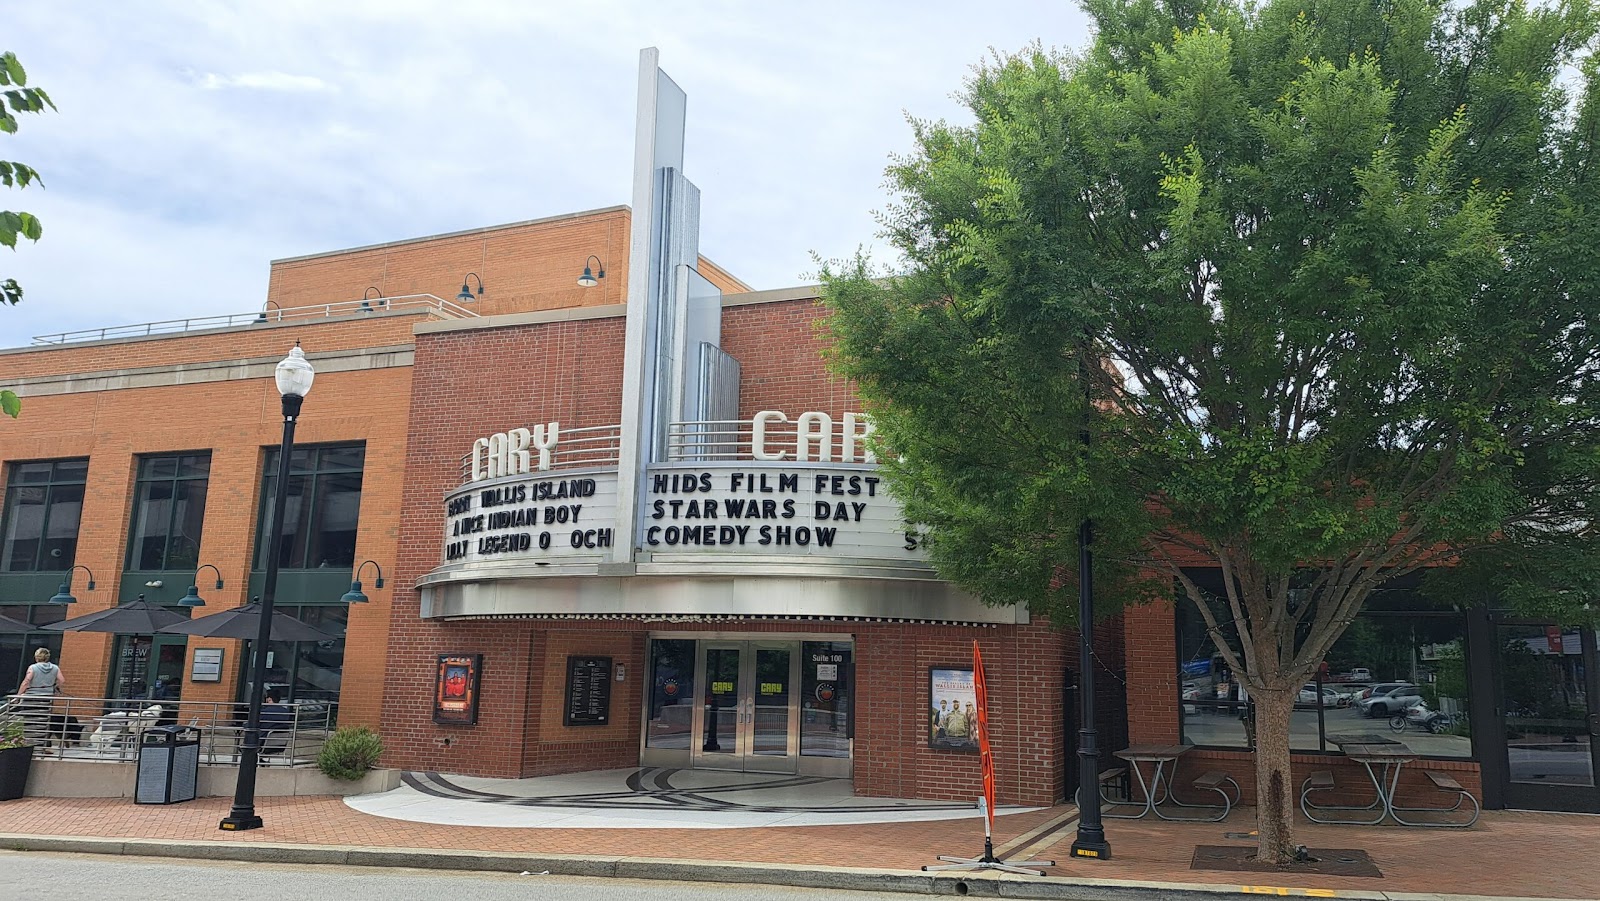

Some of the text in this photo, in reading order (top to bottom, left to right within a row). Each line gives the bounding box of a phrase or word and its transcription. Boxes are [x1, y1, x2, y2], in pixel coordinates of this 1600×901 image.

[752, 410, 904, 463] CAR
[472, 422, 559, 482] CARY
[481, 484, 526, 508] WALLIS
[532, 478, 596, 501] ISLAND
[653, 472, 880, 497] HIDS FILM FEST
[453, 520, 460, 536] A
[488, 507, 537, 531] INDIAN
[544, 504, 582, 525] BOY
[652, 498, 867, 522] STAR WARS DAY
[478, 532, 531, 555] LEGEND
[539, 531, 550, 549] O
[647, 525, 837, 547] COMEDY SHOW
[812, 654, 843, 662] Suite 100
[712, 682, 733, 691] CARY
[761, 683, 782, 693] CARY
